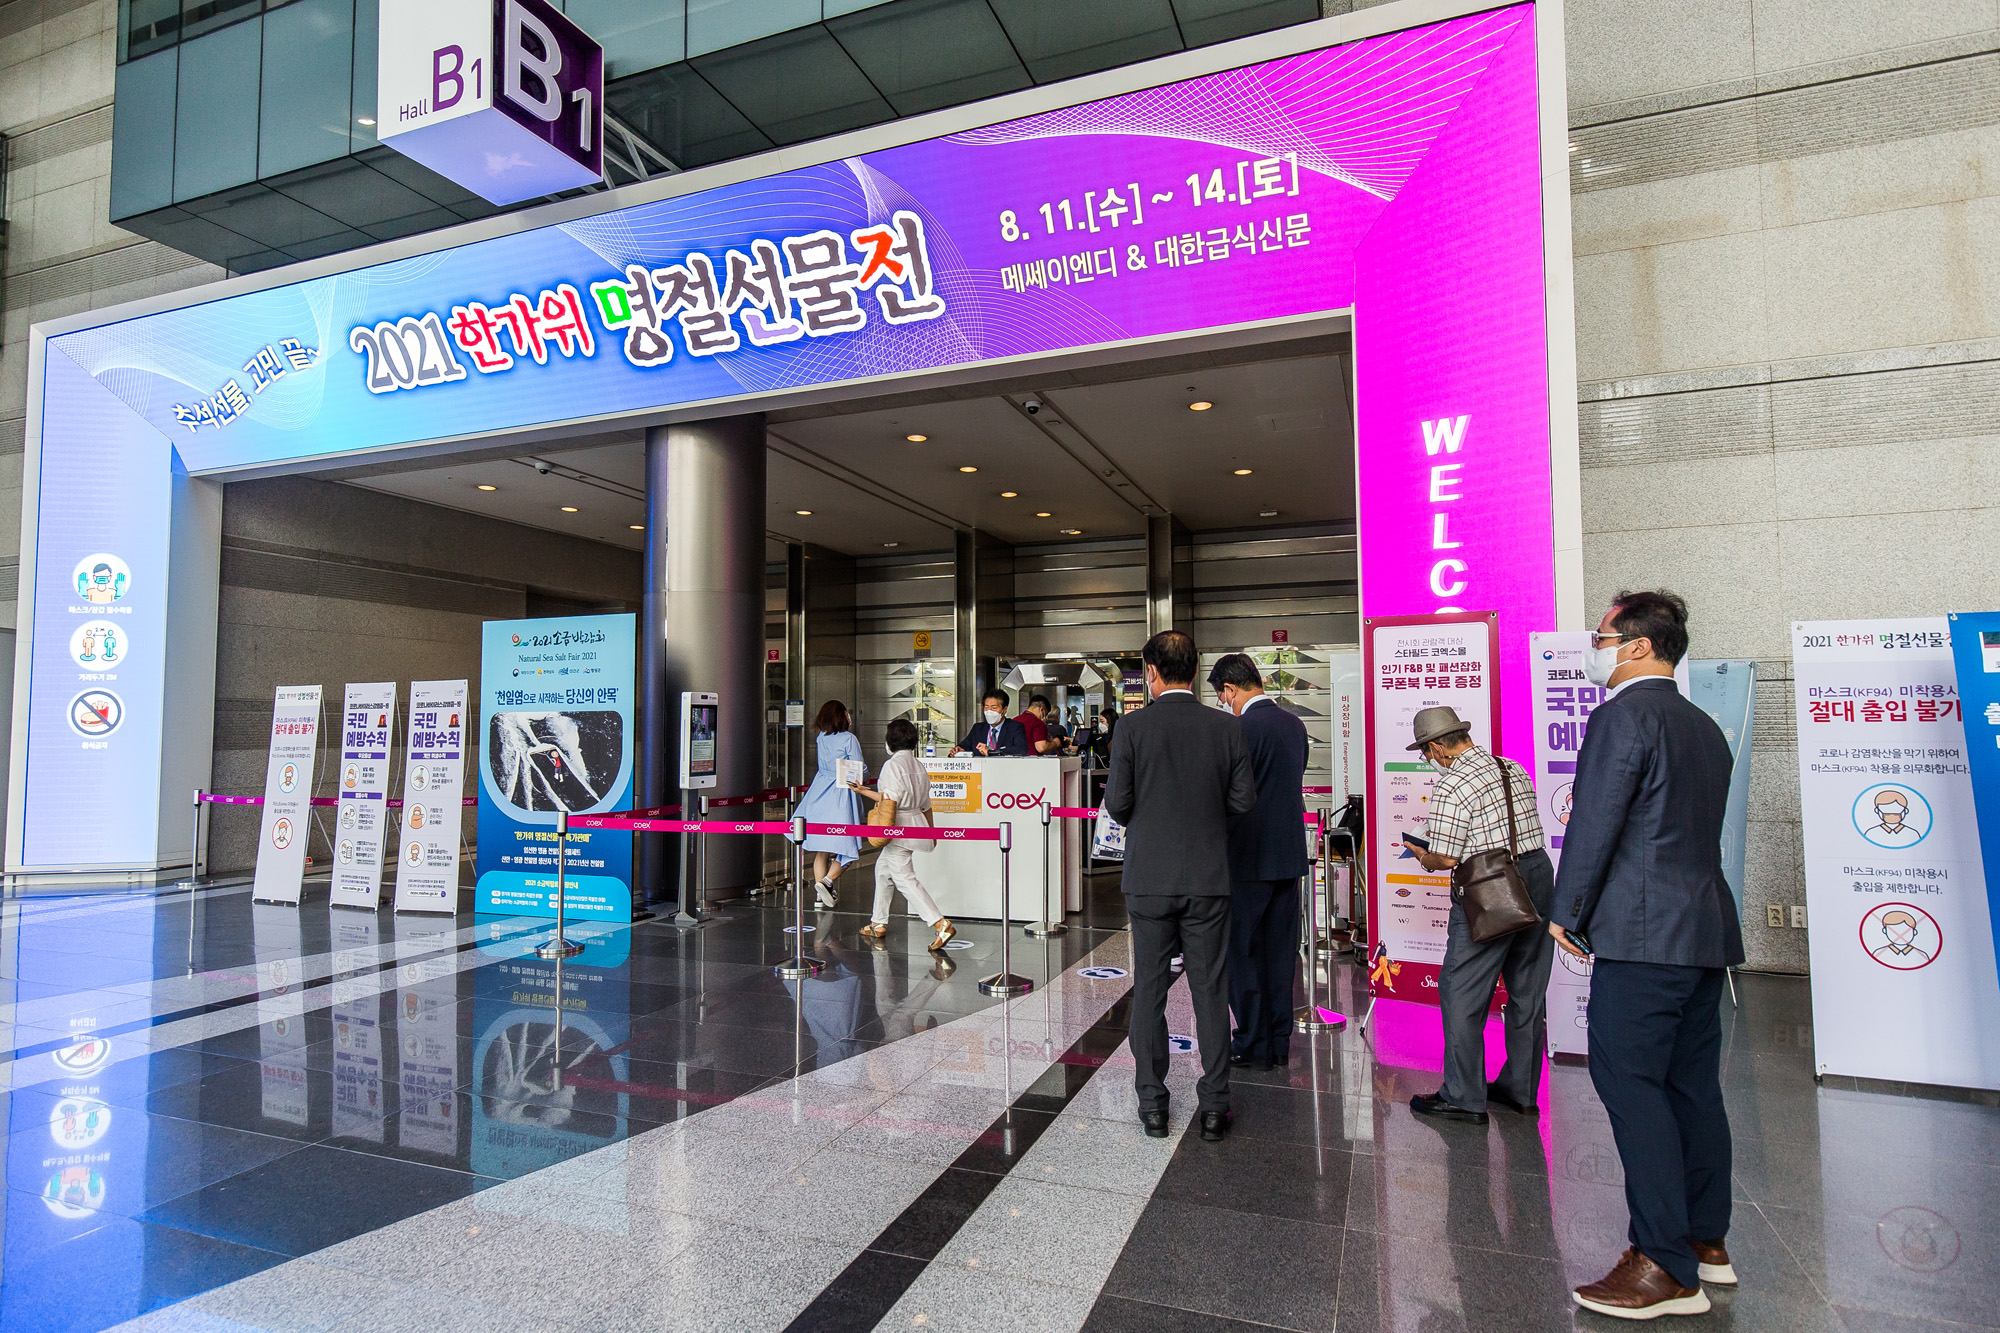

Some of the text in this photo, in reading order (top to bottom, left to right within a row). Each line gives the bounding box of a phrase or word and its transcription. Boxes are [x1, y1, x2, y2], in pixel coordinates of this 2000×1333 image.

[398, 98, 428, 122] Hall
[999, 209, 1031, 243] 8.
[1000, 213, 1312, 295] 메쎄이엔디 & 대한급식신문
[350, 211, 946, 396] 2021 한가위 명절선물전
[242, 345, 288, 395] 고민
[1421, 413, 1472, 614] WELC
[532, 629, 606, 647] 2021 소금박람회
[1397, 637, 1464, 648] 전시회 관람객 대상
[1802, 635, 1833, 649] 2021
[1836, 633, 1875, 647] 한가위
[518, 651, 597, 663] Natural Sea Salt Fair 2021
[1394, 647, 1467, 659] 스타필드 코엑스몰
[1381, 661, 1482, 675] 인기 F&B 및 패션잡화
[1381, 675, 1482, 690] 쿠폰북 무료 증정
[538, 692, 565, 705] 시작하는
[565, 687, 594, 705] 당신의
[1808, 686, 1893, 699] 마스크(KF94)
[1341, 694, 1350, 739] 비상장비함
[1808, 699, 1856, 723] 절대
[1860, 699, 1908, 723] 출입
[275, 723, 315, 735] 절대 출입 불가
[347, 712, 368, 729] 국민
[414, 712, 437, 729] 국민
[346, 731, 387, 748] 예방수칙
[413, 731, 460, 748] 예방수칙
[1819, 748, 1960, 759] 코로나 감염확산을 막기 위하여
[1811, 763, 1971, 775] 마스크(KF94) 착용을 의무화합니다.
[986, 787, 1046, 810] coex
[586, 818, 966, 838] coex coex coex coex coex coex coex
[1843, 866, 1948, 880] 마스크(KF94) 미착용시
[1852, 881, 1943, 895] 출입을 제한합니다.
